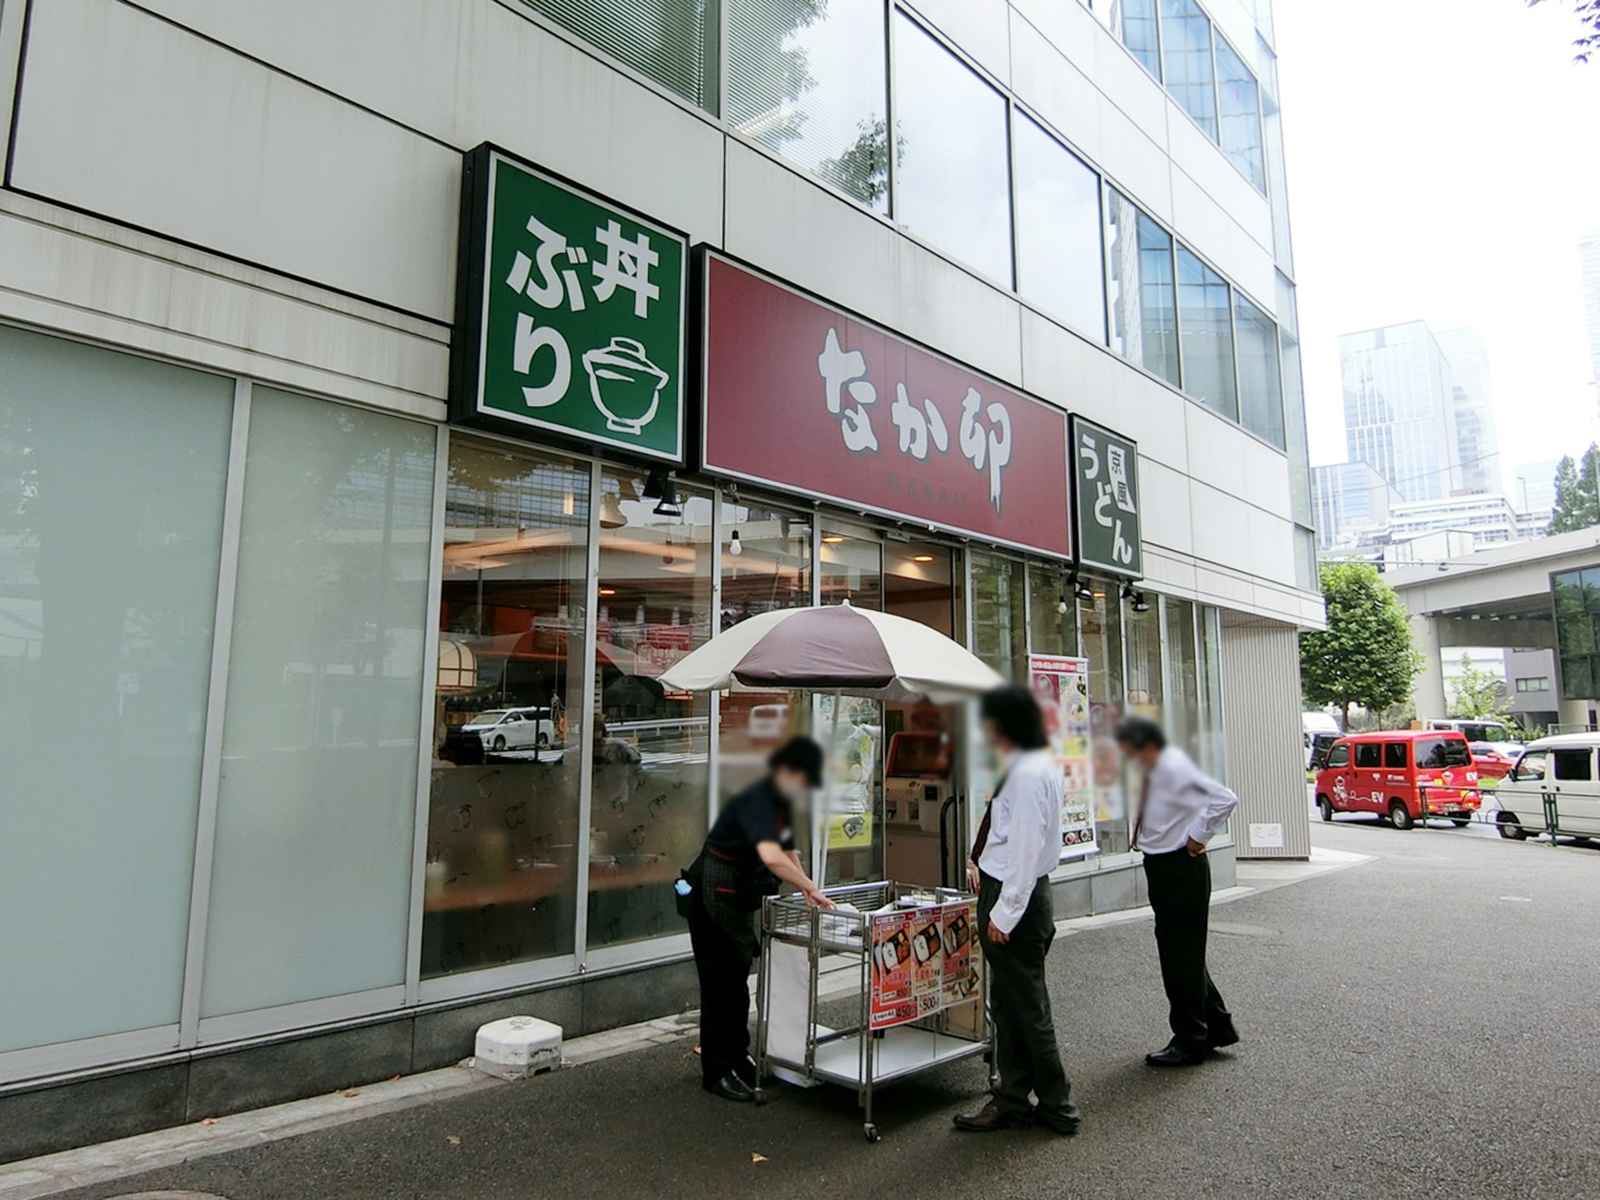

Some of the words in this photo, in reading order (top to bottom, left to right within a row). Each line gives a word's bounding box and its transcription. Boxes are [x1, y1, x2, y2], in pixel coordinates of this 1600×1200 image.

[817, 326, 1012, 518] なか卯
[1080, 433, 1133, 565] うどん
[1370, 791, 1384, 804] EV
[1466, 772, 1478, 781] EV
